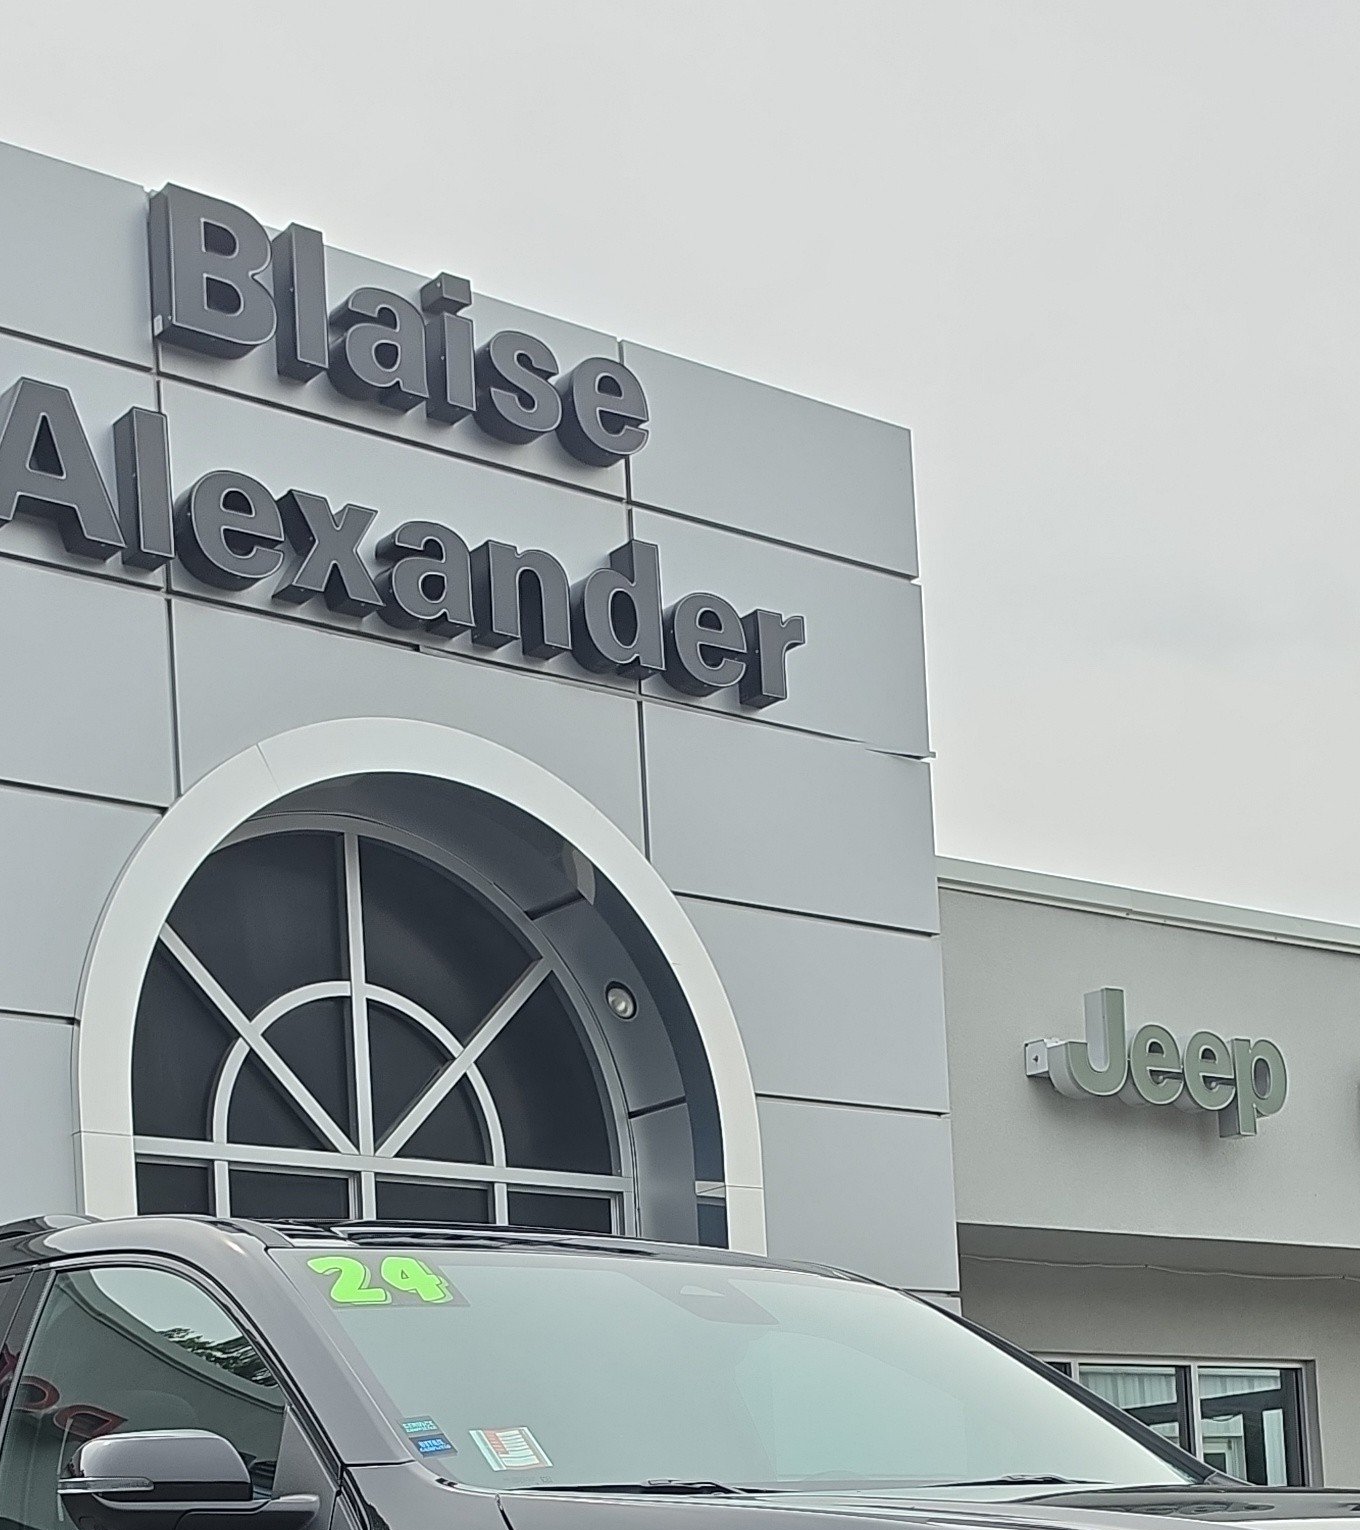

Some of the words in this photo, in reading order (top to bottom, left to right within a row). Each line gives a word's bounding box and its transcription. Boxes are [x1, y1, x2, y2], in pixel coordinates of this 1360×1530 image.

[150, 183, 650, 467] Blaise
[1049, 987, 1287, 1138] Jeep
[307, 1256, 454, 1305] 24
